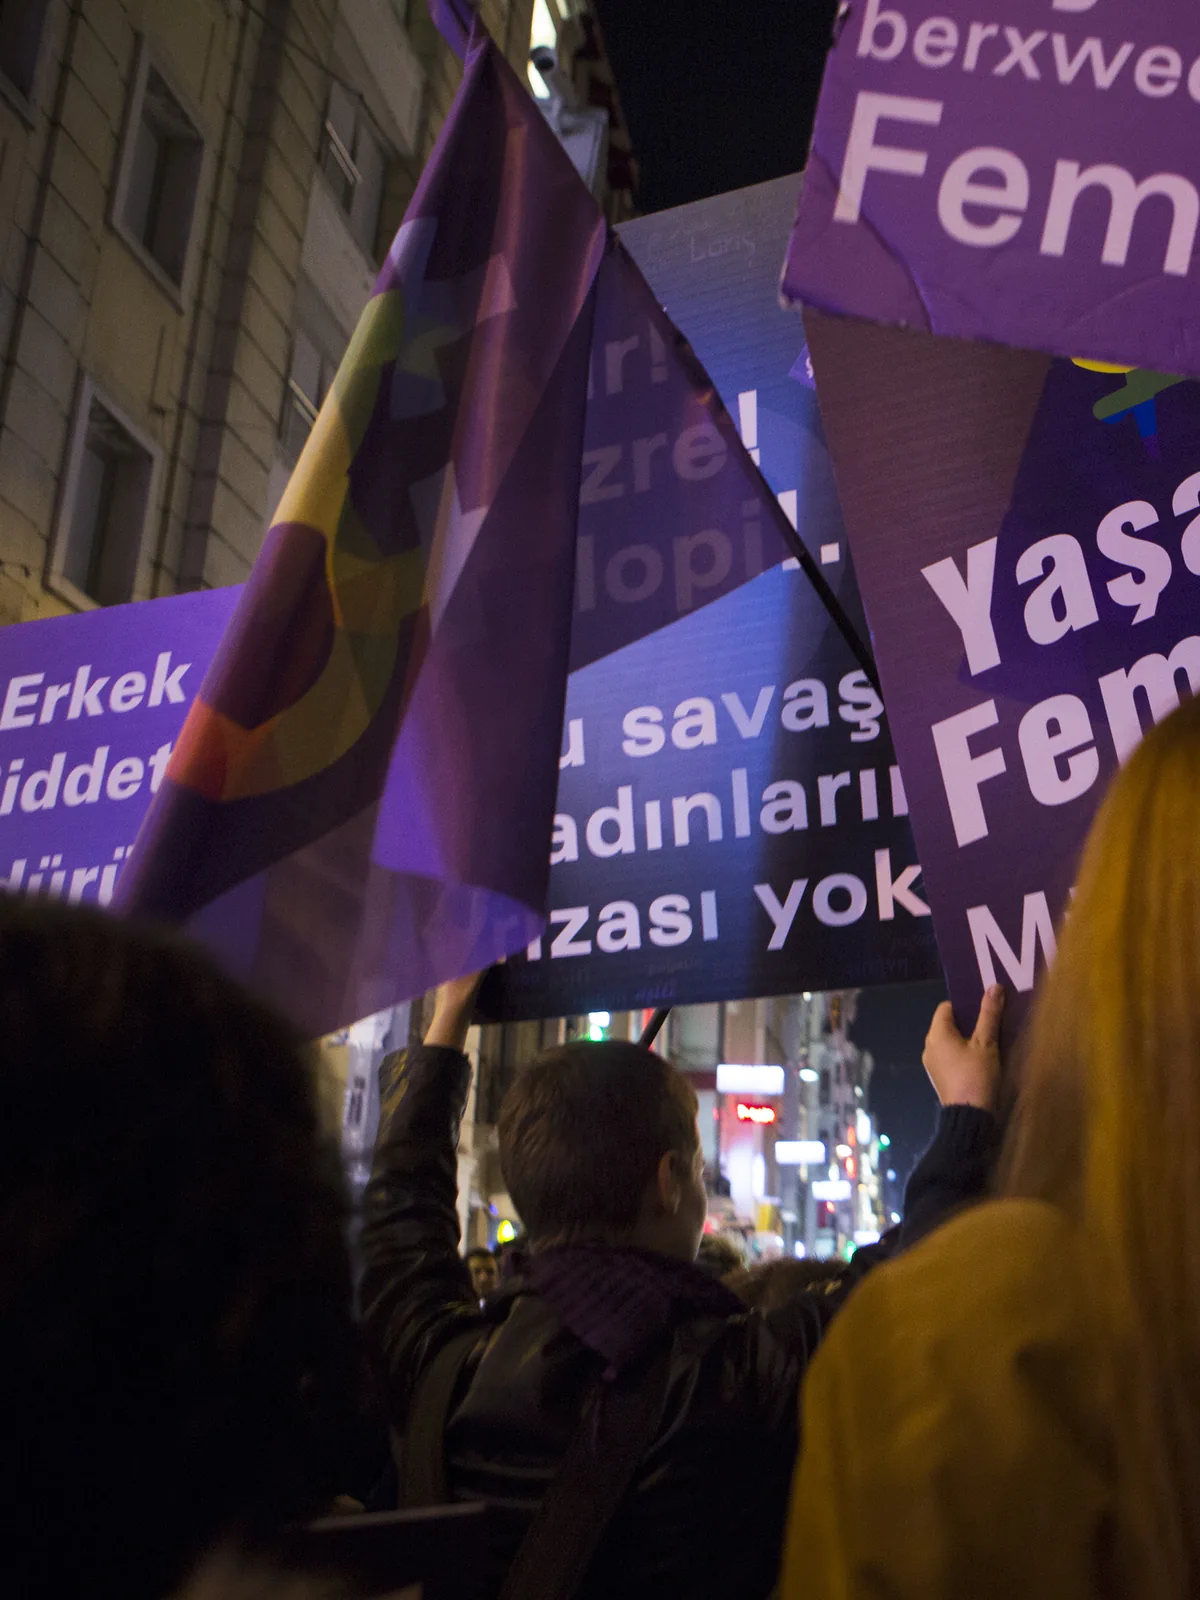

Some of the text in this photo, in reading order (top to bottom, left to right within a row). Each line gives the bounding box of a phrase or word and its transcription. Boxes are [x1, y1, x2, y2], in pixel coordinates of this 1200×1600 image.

[586, 312, 669, 400] r!
[0, 650, 193, 731] Erkek
[0, 741, 172, 816] iddet
[753, 848, 932, 951] yok
